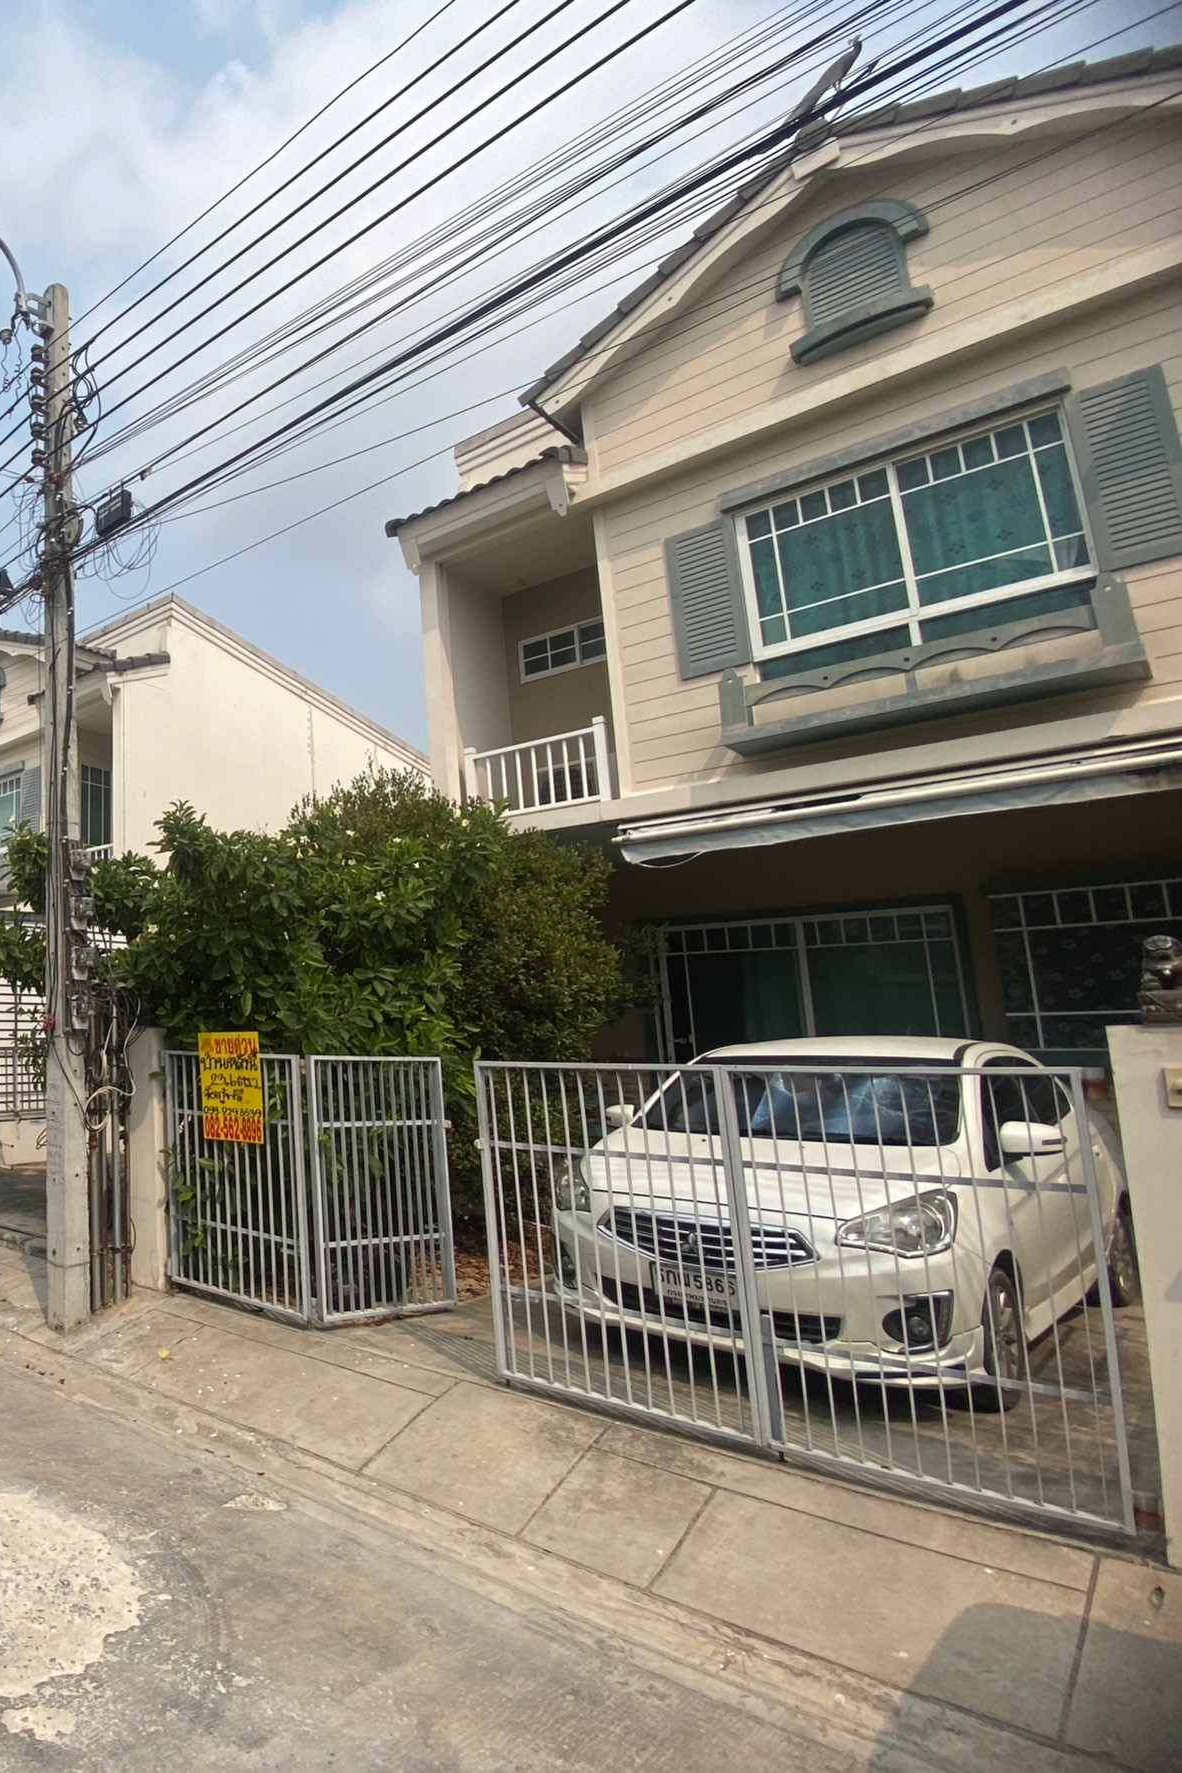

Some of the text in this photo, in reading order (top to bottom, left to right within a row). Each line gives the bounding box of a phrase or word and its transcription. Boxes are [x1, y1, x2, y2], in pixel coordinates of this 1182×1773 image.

[214, 1034, 256, 1055] ขายด่วน
[205, 1115, 262, 1142] 082-562-8896
